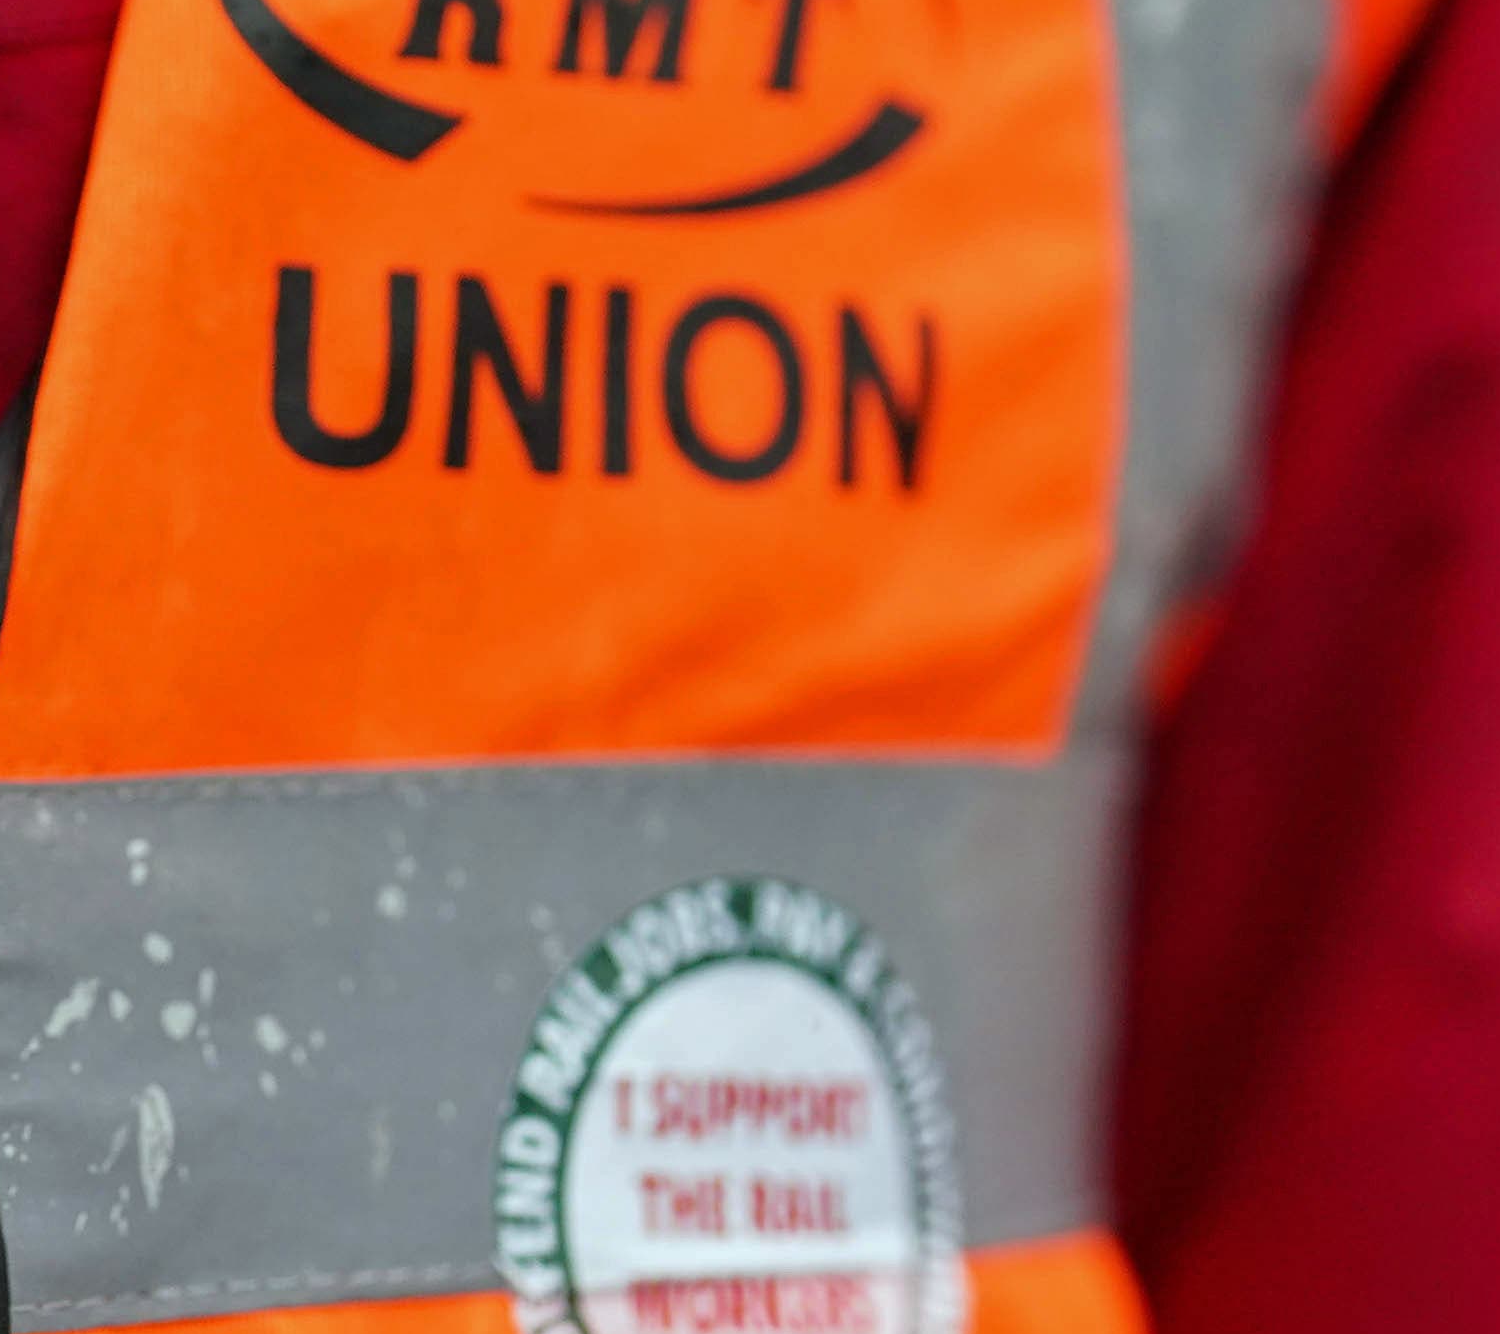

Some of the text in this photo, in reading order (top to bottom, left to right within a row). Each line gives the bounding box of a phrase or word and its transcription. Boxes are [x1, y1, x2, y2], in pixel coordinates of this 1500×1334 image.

[272, 264, 936, 491] UNION
[614, 1074, 870, 1141] I SUPPORT
[639, 1172, 849, 1238] THE RAIL
